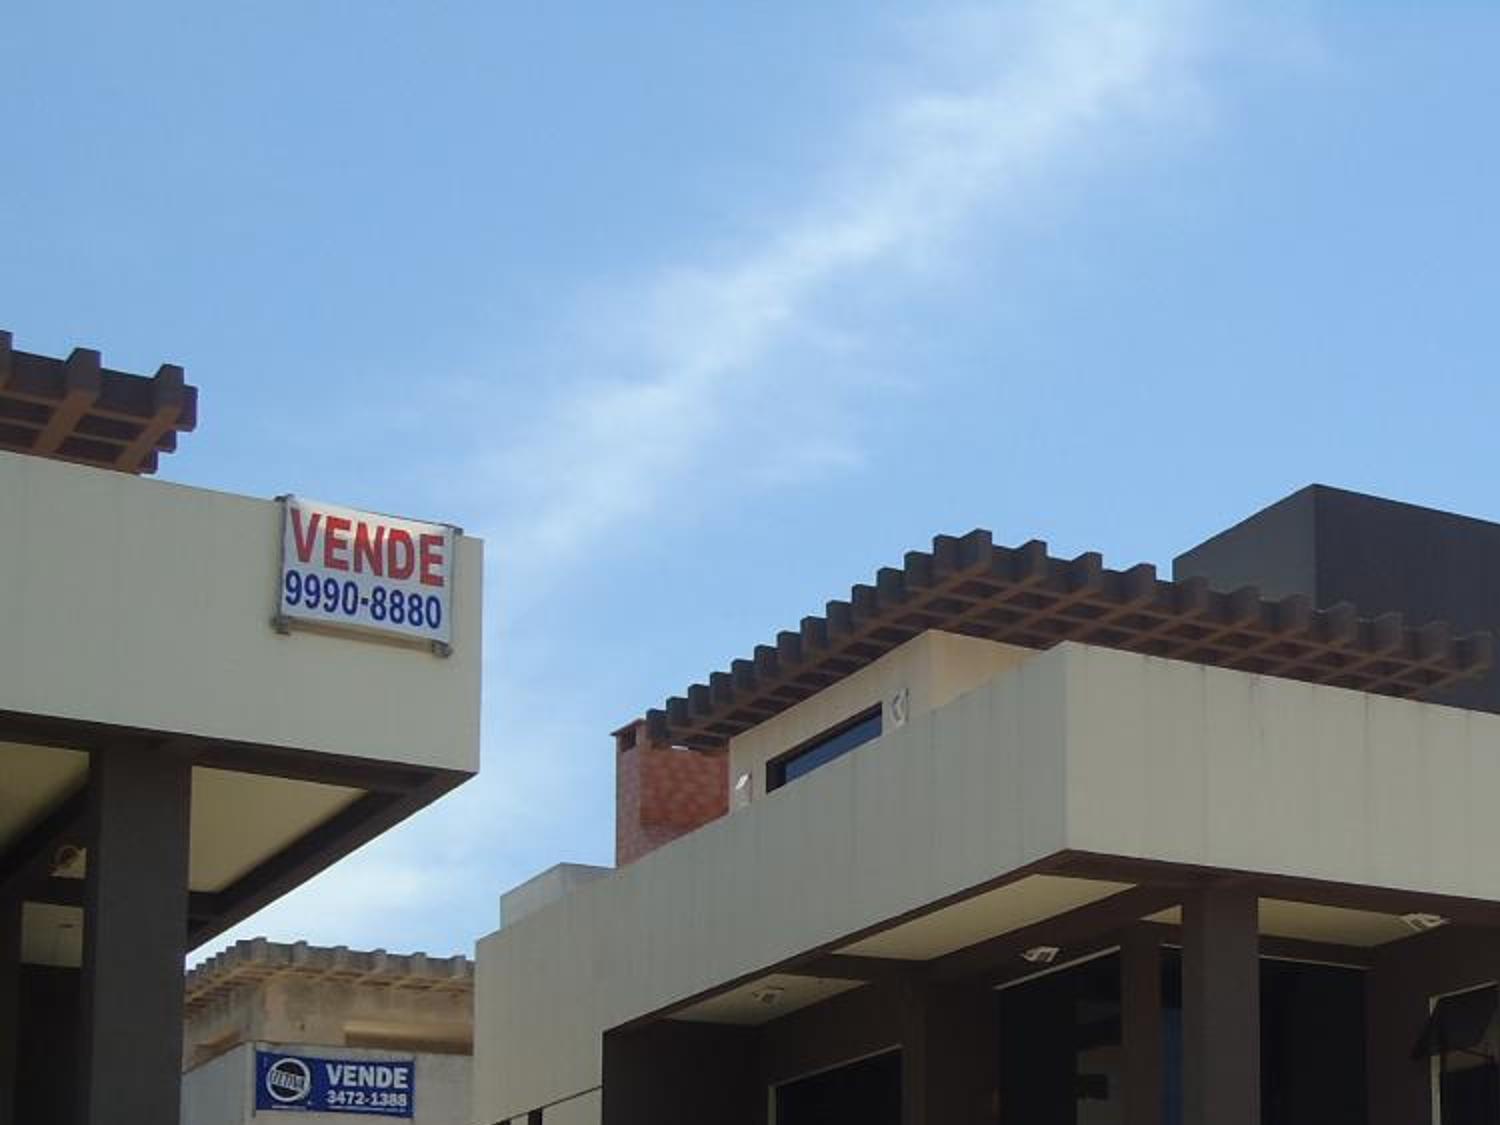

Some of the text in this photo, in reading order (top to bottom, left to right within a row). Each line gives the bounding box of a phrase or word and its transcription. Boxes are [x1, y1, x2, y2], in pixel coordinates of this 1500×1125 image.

[290, 507, 444, 588] VENDE
[285, 569, 442, 629] 9990-8880
[326, 1063, 409, 1089] VENDE
